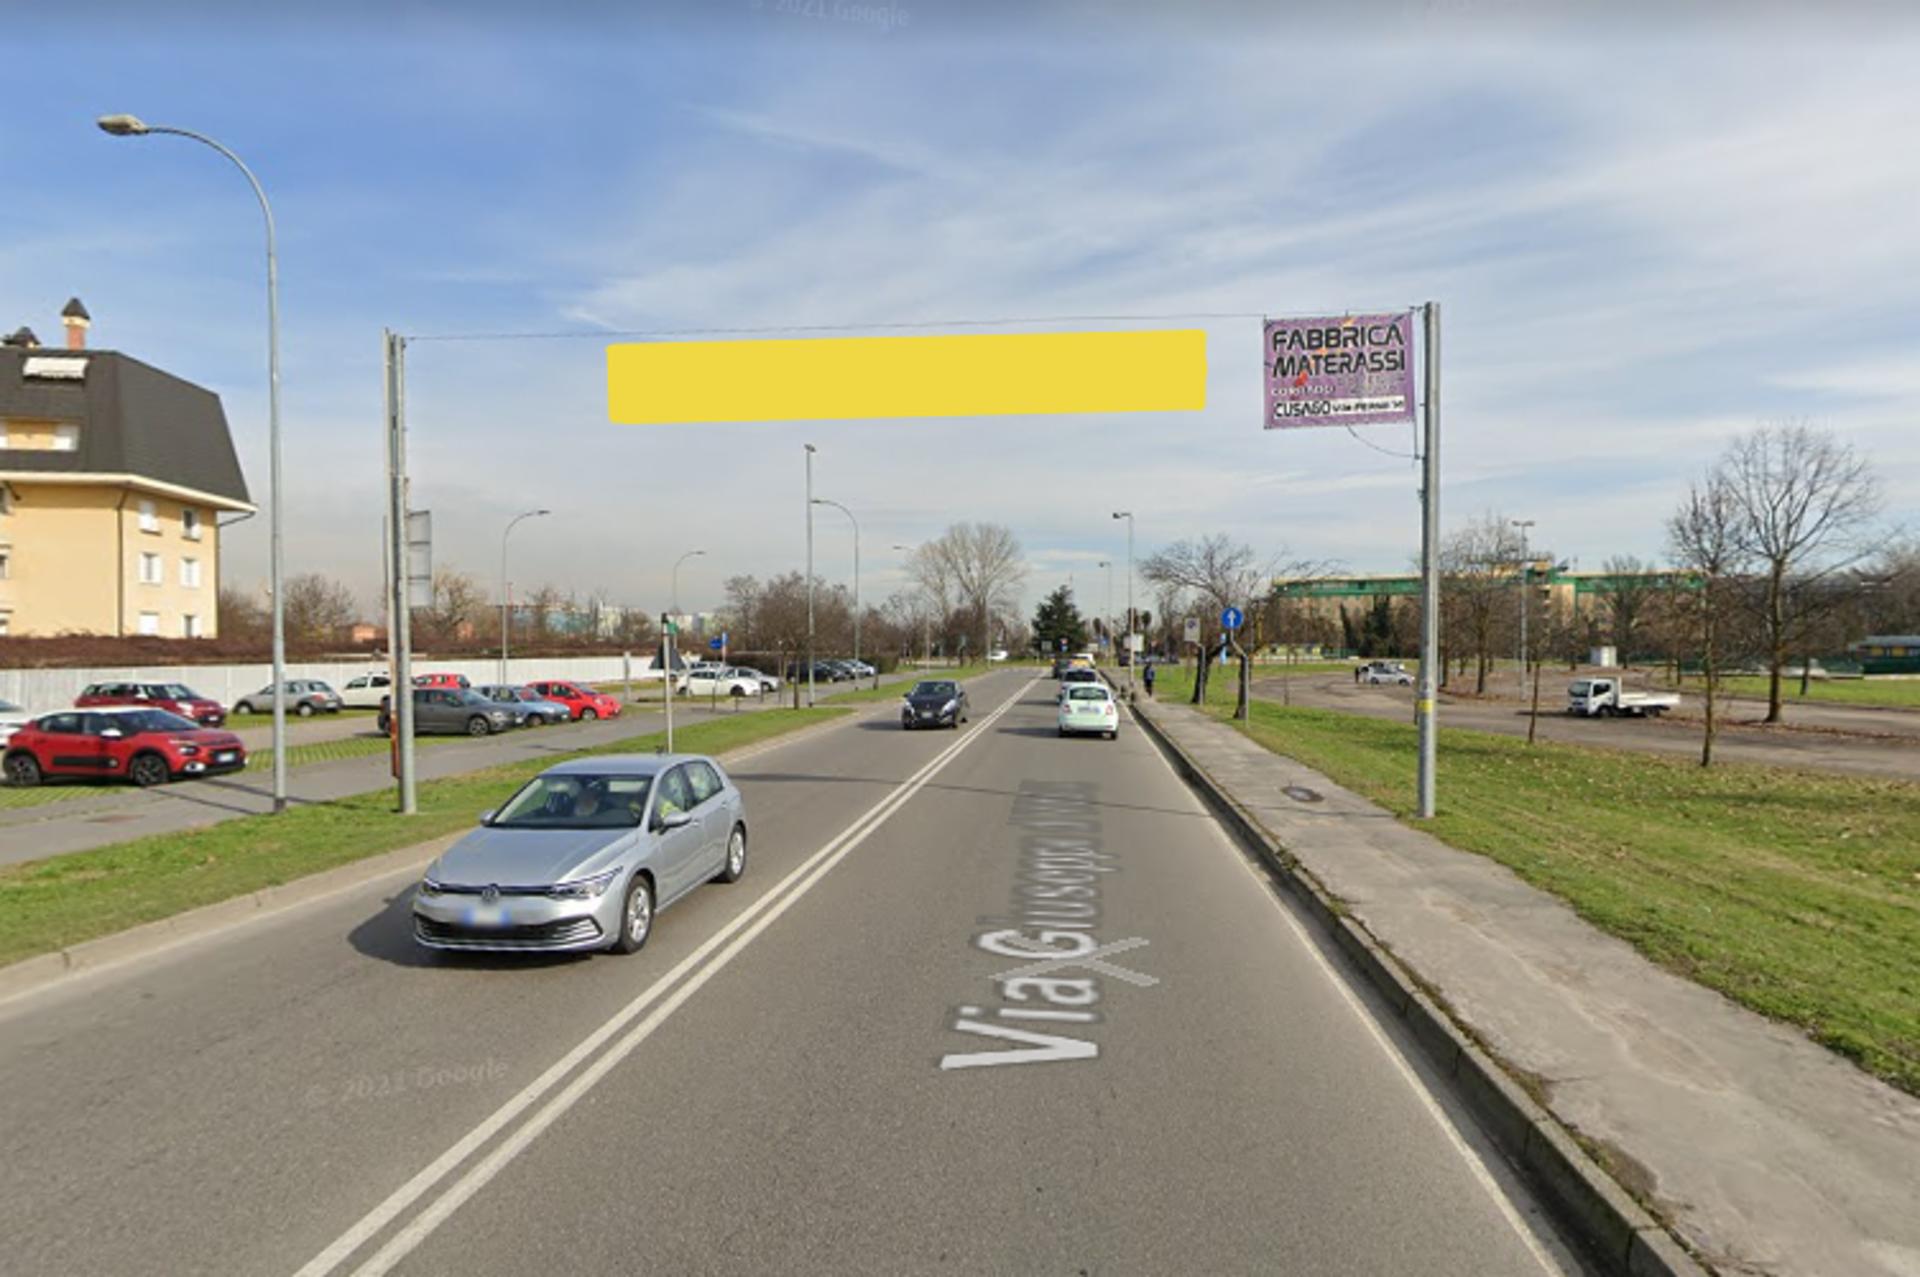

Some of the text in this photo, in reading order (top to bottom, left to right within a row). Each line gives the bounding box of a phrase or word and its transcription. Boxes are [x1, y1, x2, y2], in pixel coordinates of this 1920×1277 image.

[1273, 324, 1404, 351] FABBRICA
[1273, 350, 1405, 378] MATERASSI
[1275, 400, 1331, 418] CUSAGO
